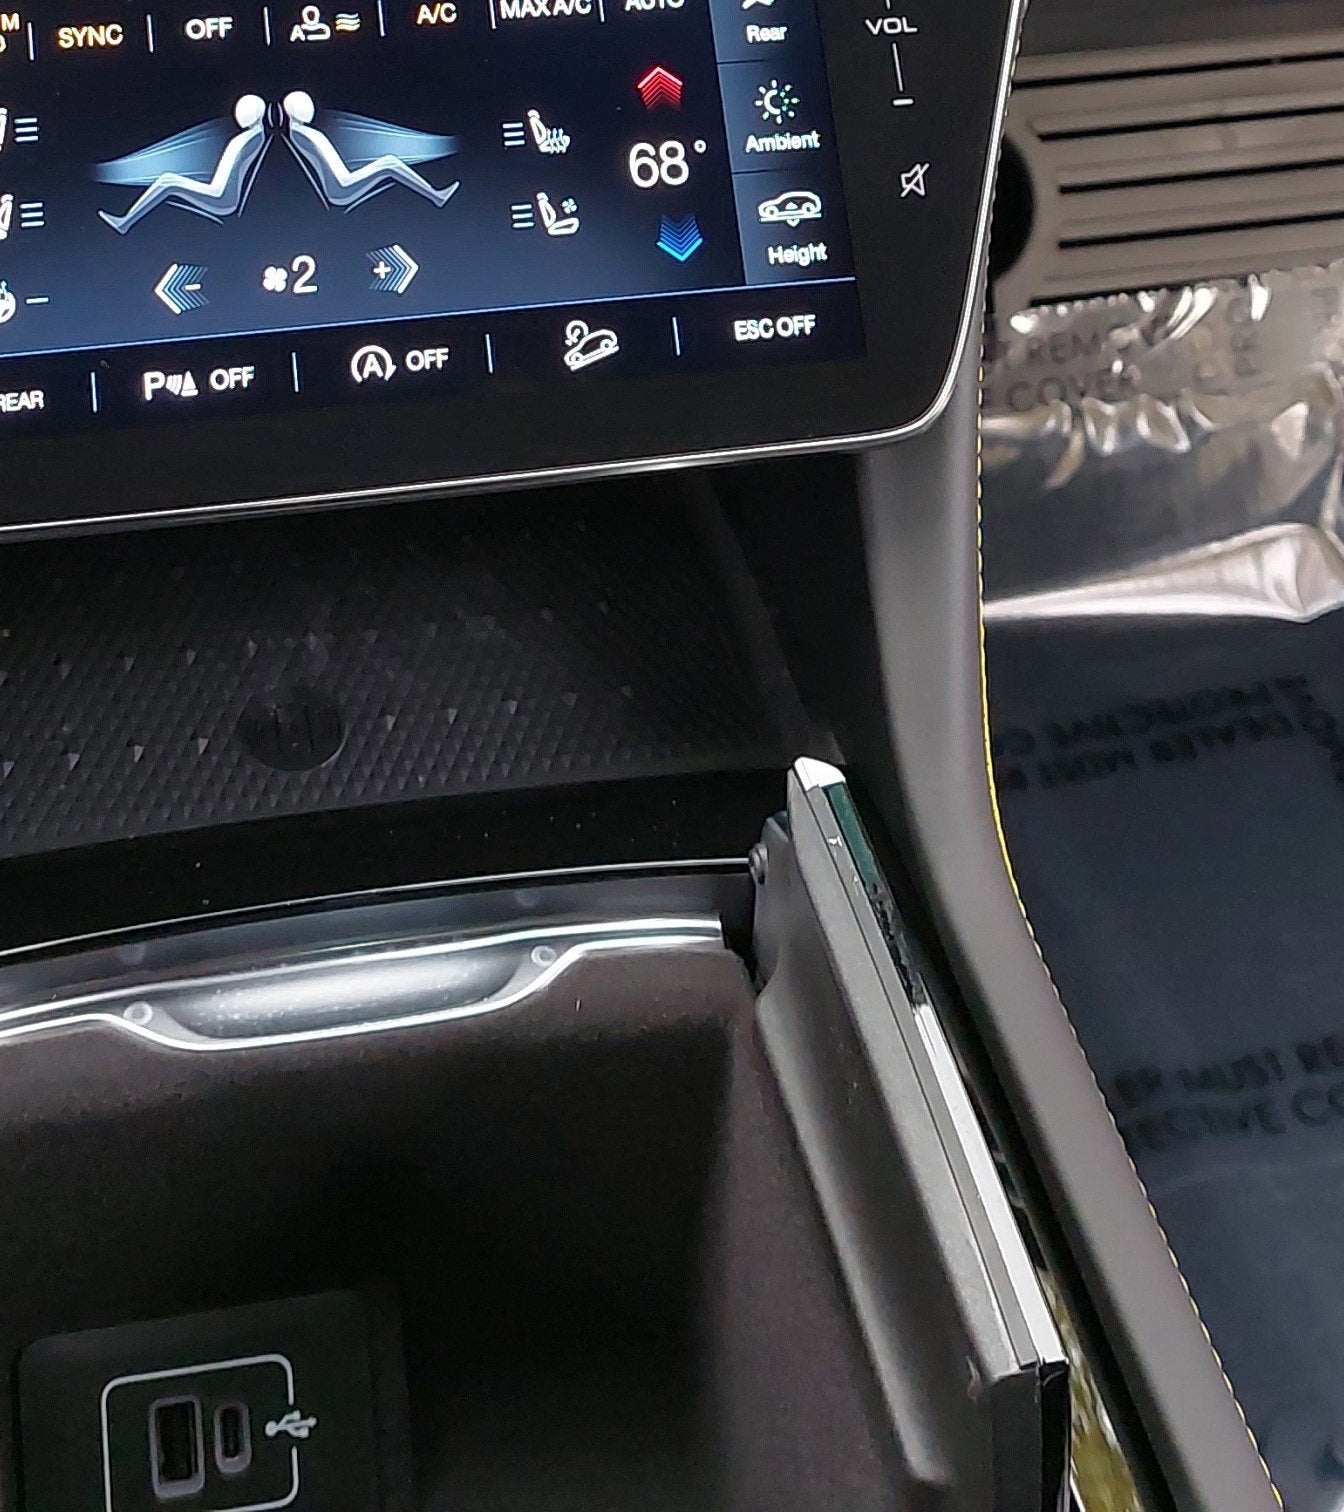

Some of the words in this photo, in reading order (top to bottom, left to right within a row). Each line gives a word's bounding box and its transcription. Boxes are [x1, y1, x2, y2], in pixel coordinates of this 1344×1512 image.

[1, 13, 20, 33] M
[416, 2, 457, 26] A/C
[865, 17, 918, 34] VOL
[57, 24, 124, 50] SYNC
[185, 17, 234, 41] OFF
[746, 23, 787, 44] Rear
[745, 130, 821, 154] Ambient
[767, 241, 829, 266] Height
[293, 254, 318, 294] 2
[734, 317, 775, 342] ESC
[776, 313, 817, 338] OFF
[405, 347, 450, 372] OFF
[209, 365, 256, 392] OFF
